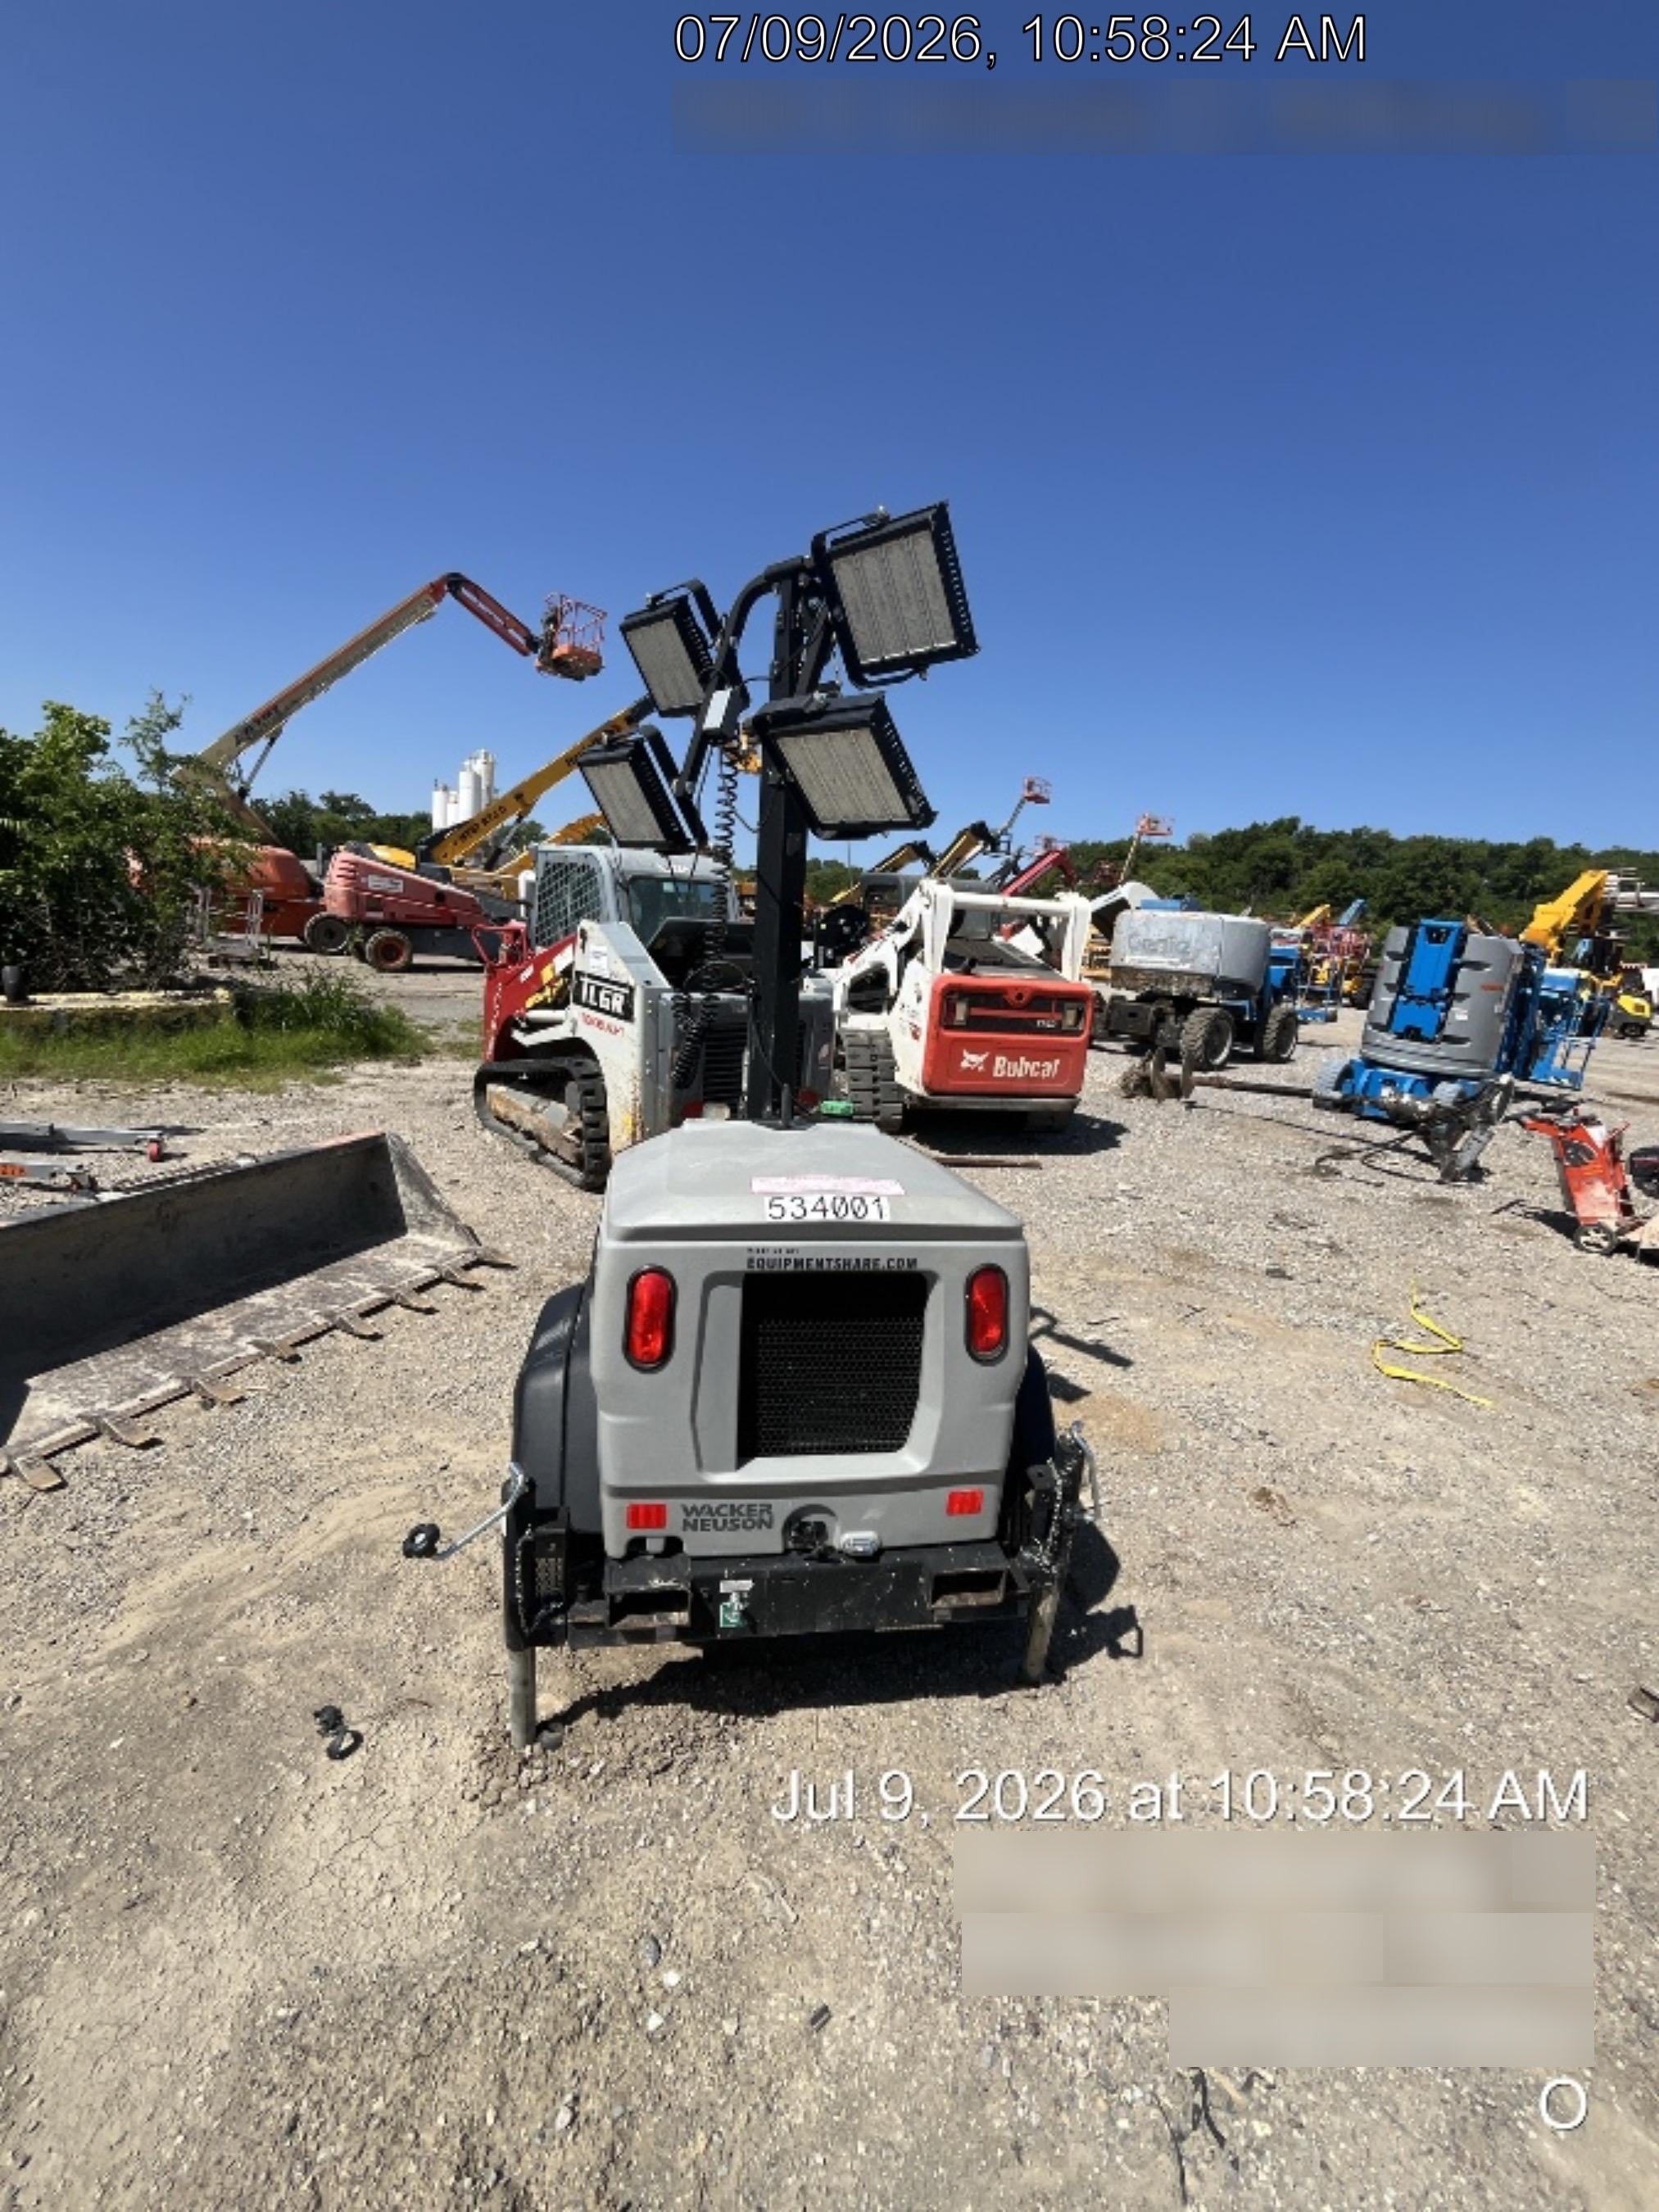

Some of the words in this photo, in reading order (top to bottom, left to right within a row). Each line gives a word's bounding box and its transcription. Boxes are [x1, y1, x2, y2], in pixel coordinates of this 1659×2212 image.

[993, 1056, 1060, 1077] Bobcat
[768, 1196, 884, 1220] 534001
[746, 1258, 918, 1271] EQUIPMENTSHARE.COM
[682, 1504, 773, 1518] WACKER
[682, 1519, 773, 1531] NEUSON
